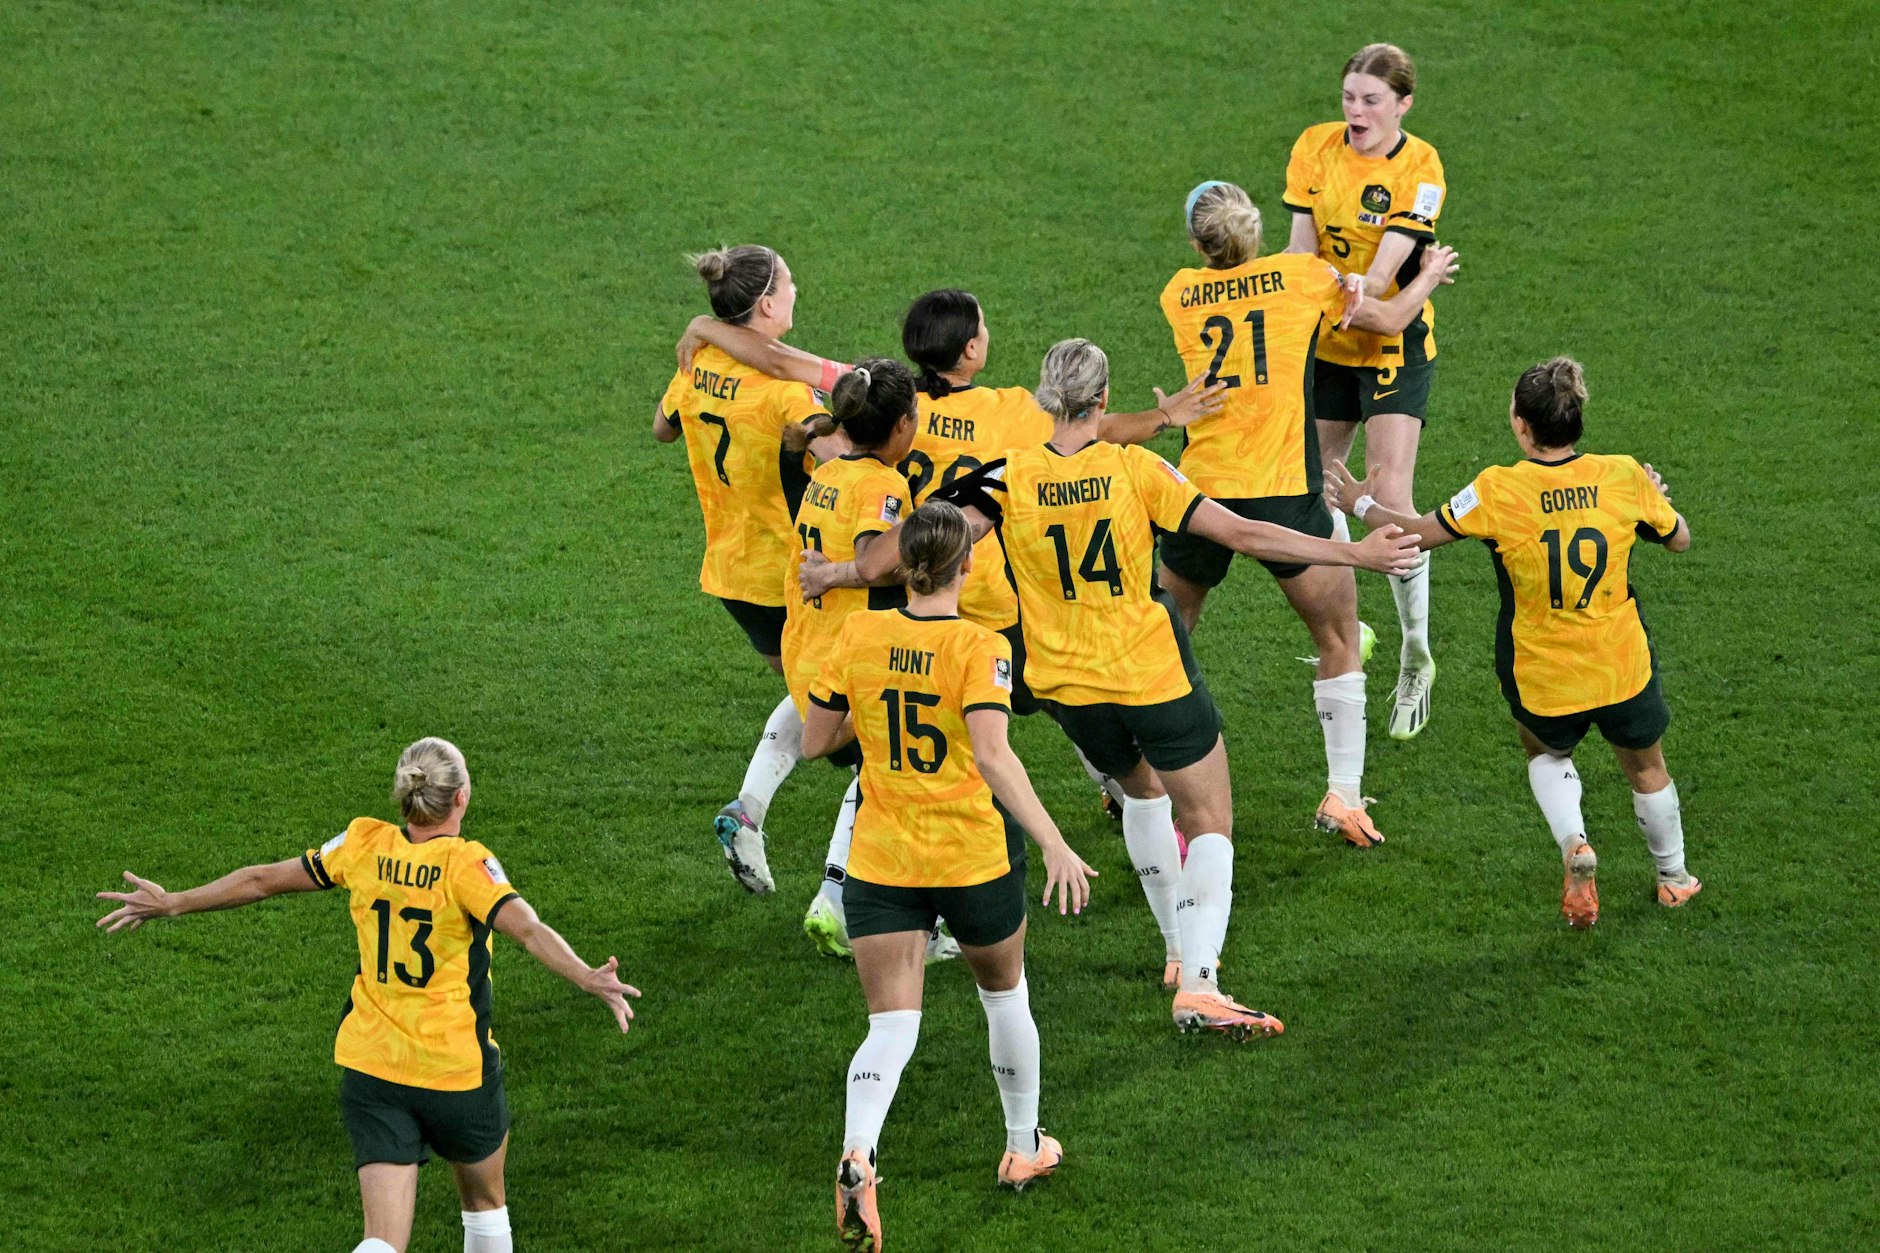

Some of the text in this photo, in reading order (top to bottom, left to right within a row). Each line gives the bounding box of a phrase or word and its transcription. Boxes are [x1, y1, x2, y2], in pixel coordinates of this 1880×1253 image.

[1325, 225, 1351, 259] 5
[1180, 271, 1285, 308] CARPENTER
[1199, 309, 1269, 389] 21
[694, 367, 741, 401] CATLEY
[927, 412, 975, 442] KERR
[699, 411, 731, 487] 7
[804, 480, 839, 511] OWLER
[1037, 476, 1112, 507] KENNEDY
[1540, 485, 1599, 514] GORRY
[1044, 518, 1123, 600] 14
[1539, 527, 1609, 610] 19
[889, 647, 935, 676] HUNT
[879, 688, 948, 774] 15
[377, 855, 441, 890] YALLOP
[370, 898, 435, 988] 13
[852, 1072, 881, 1083] AUS
